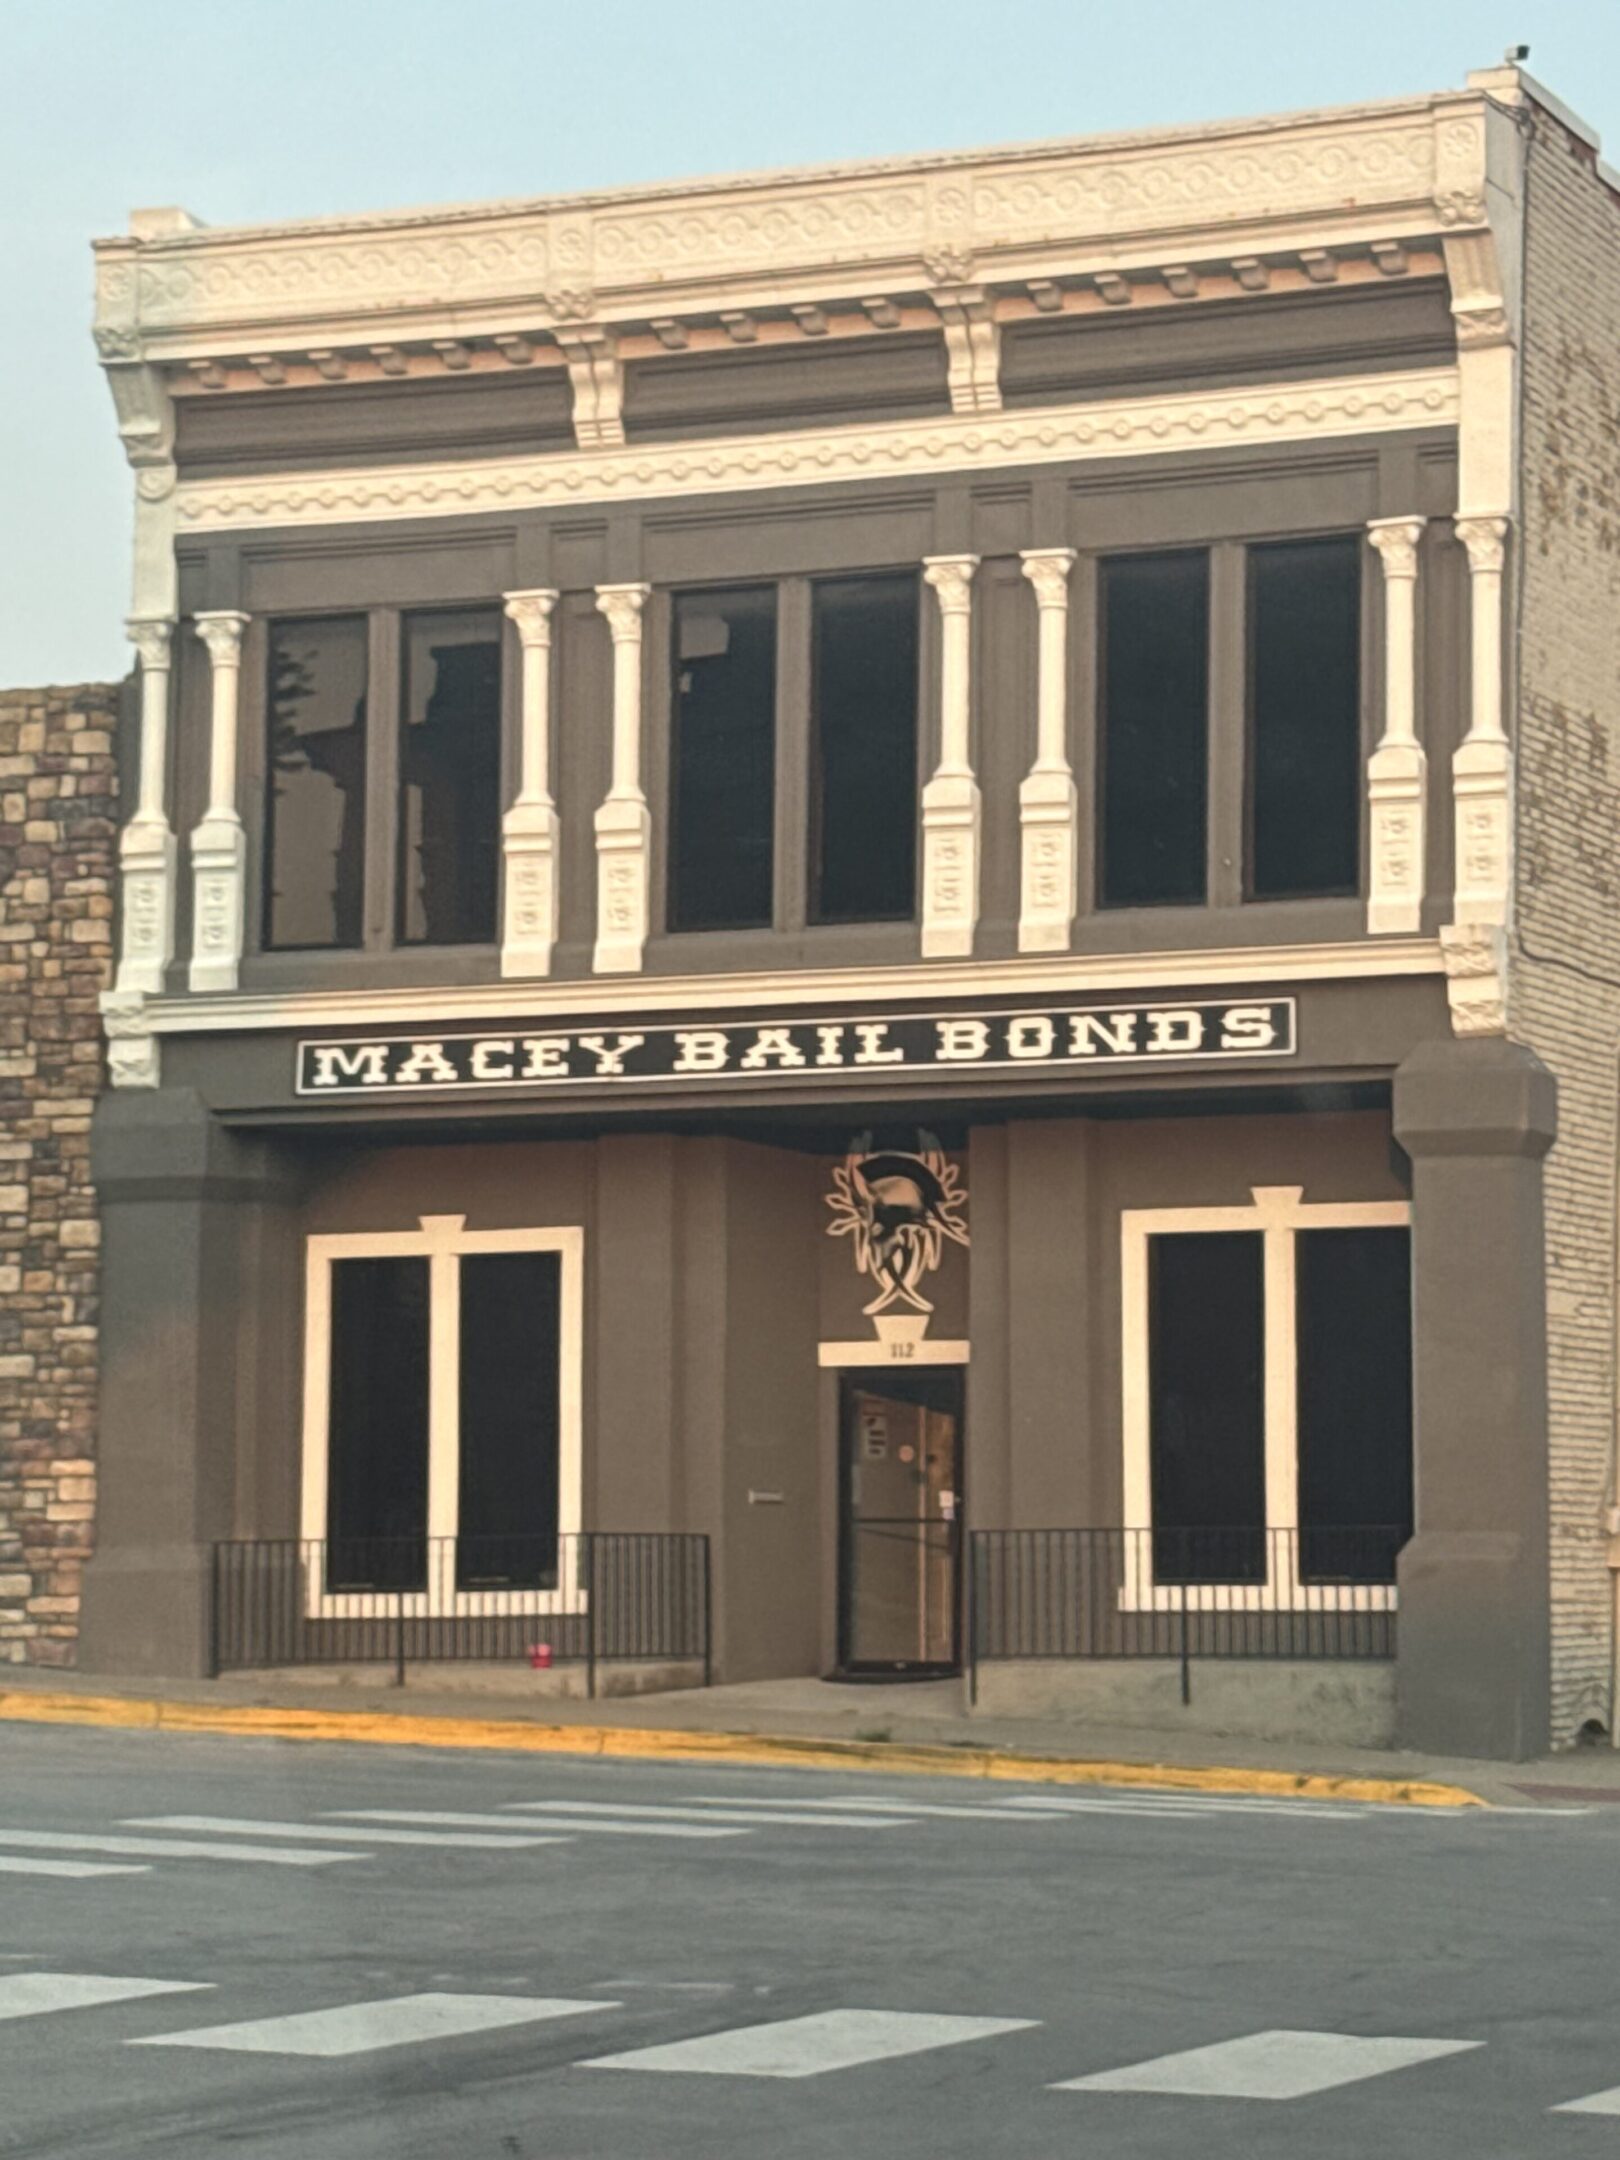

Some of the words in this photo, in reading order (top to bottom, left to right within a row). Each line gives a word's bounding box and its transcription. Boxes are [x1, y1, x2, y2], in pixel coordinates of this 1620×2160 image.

[313, 1034, 644, 1086] MACEY
[673, 1024, 904, 1071] BAIL
[935, 1008, 1278, 1060] BONDS
[890, 1342, 915, 1358] 112
